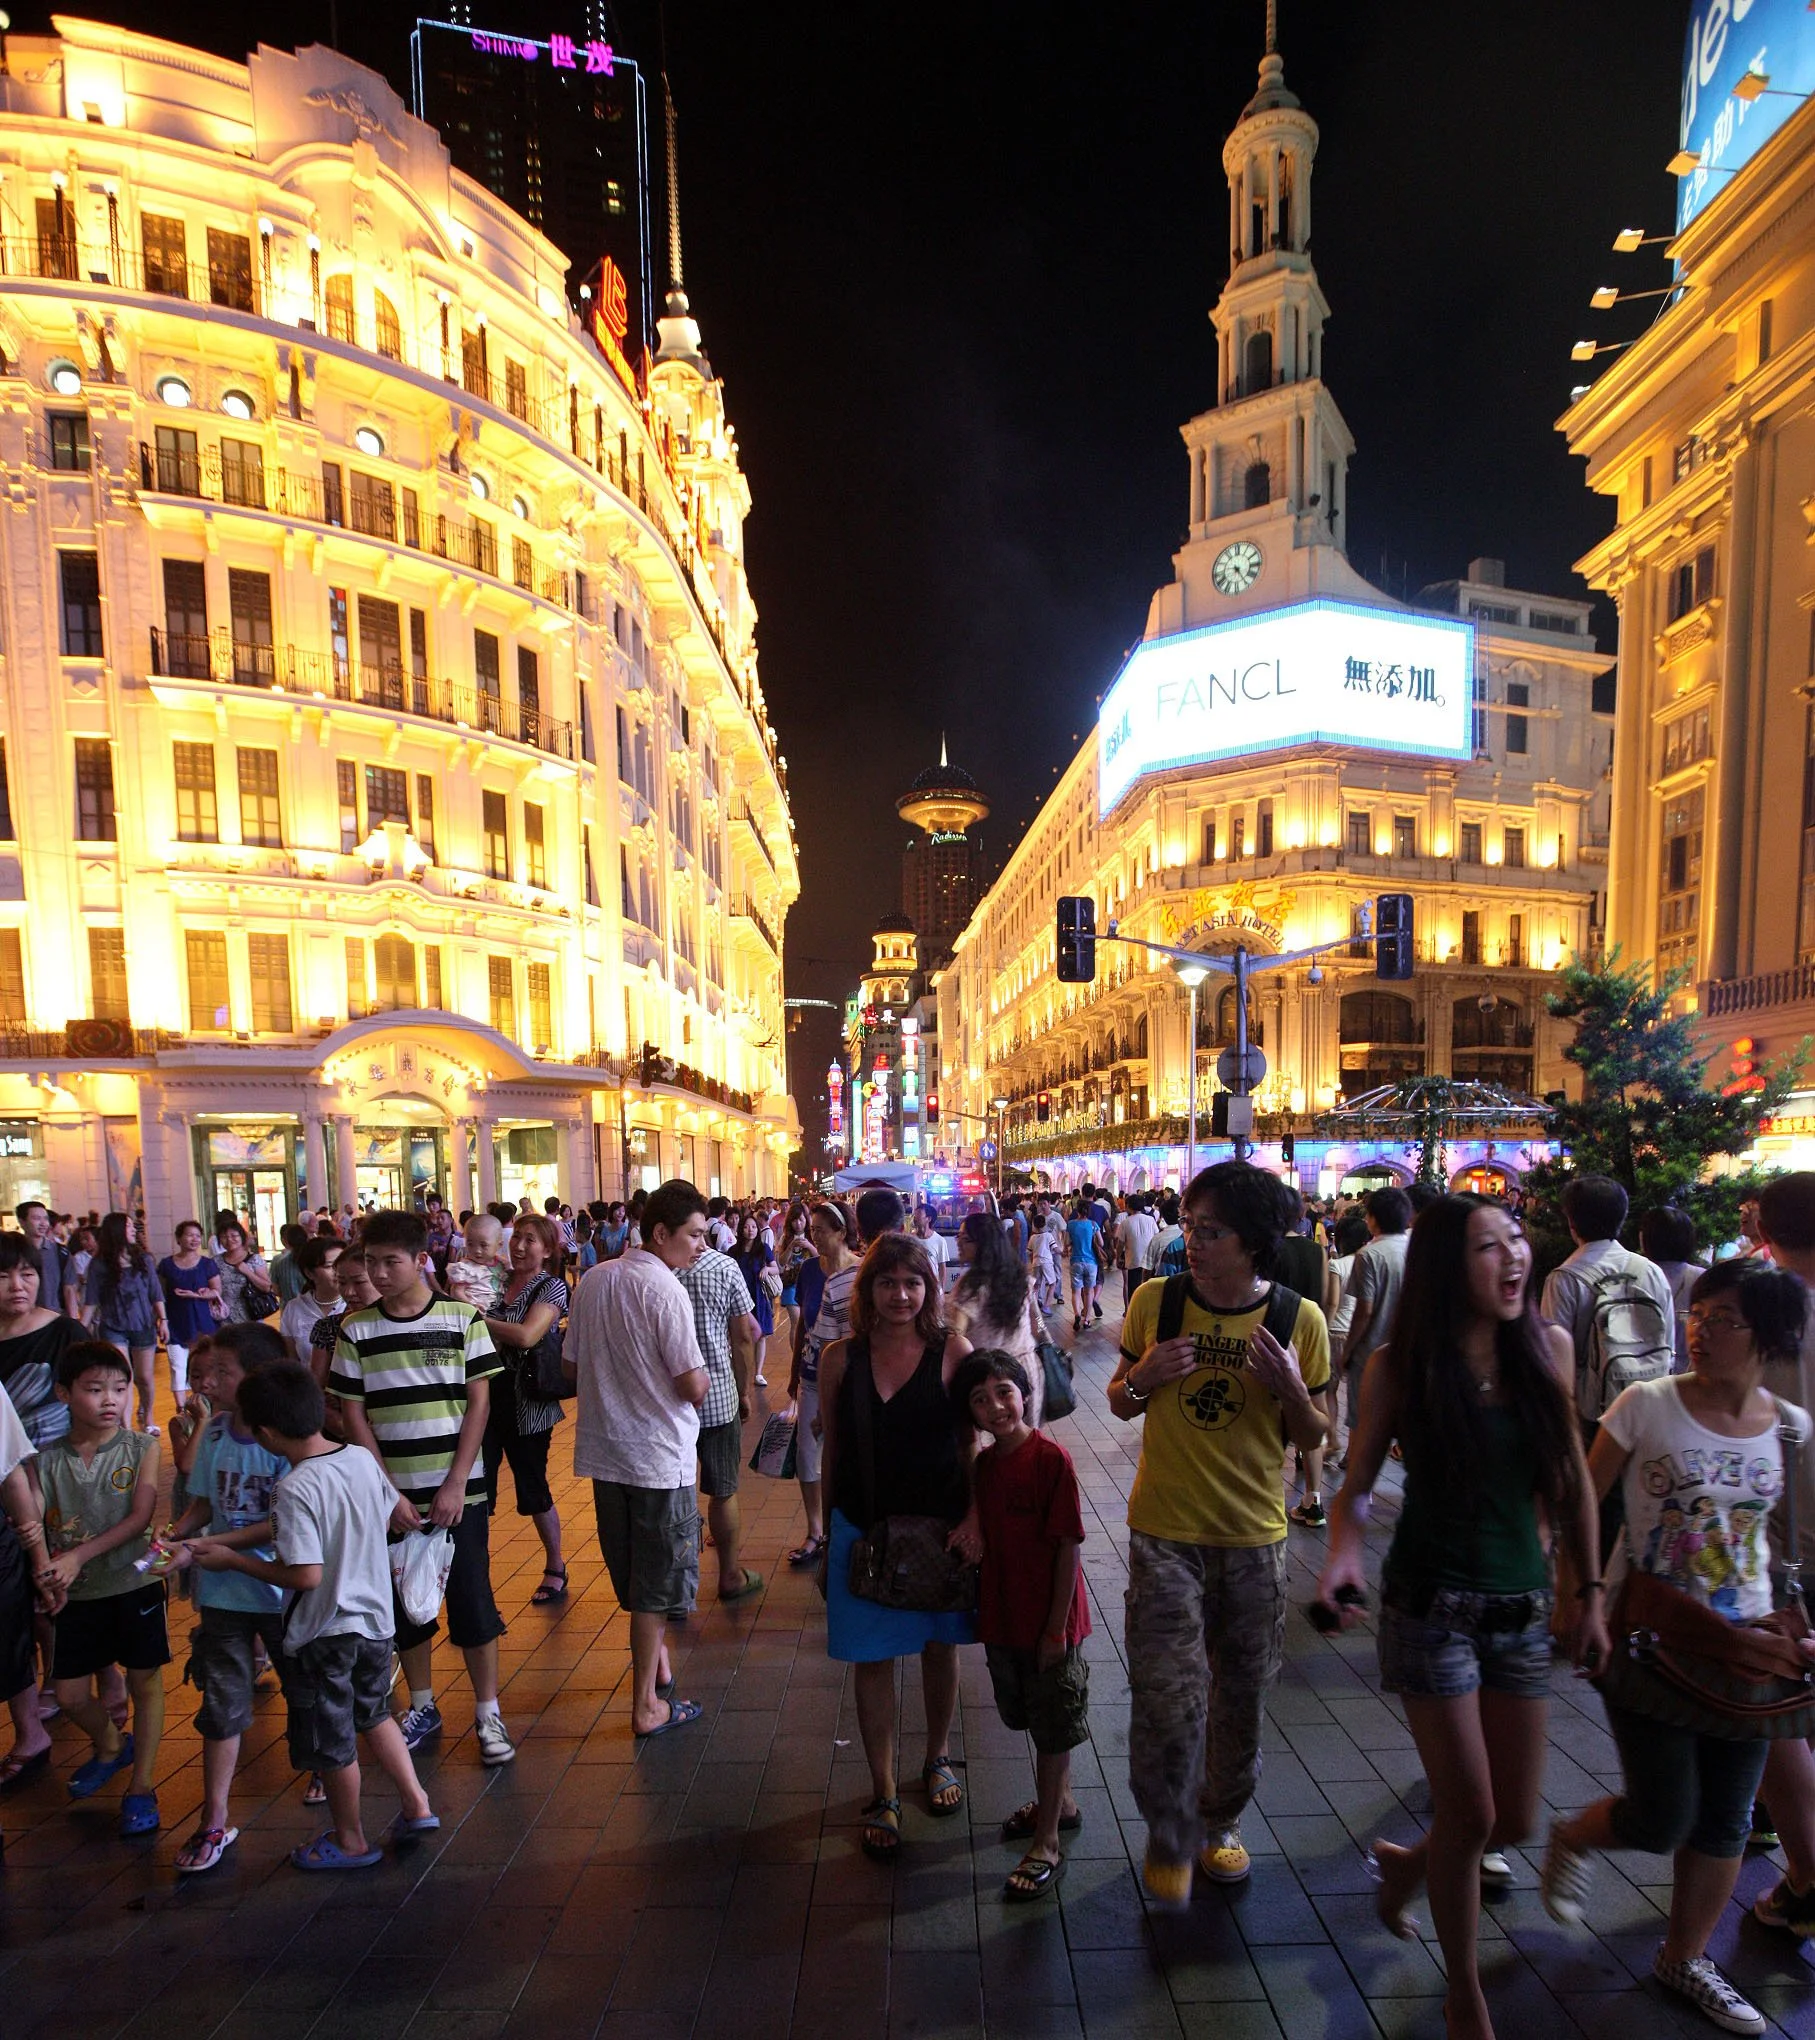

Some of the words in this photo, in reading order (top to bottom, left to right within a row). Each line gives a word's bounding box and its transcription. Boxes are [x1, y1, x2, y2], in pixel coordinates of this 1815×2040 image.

[1156, 658, 1297, 723] FANCL
[1174, 924, 1199, 949] AST
[1202, 914, 1238, 932] ASIA
[1241, 914, 1285, 949] HOTEL
[1192, 1349, 1245, 1370] IGFOO
